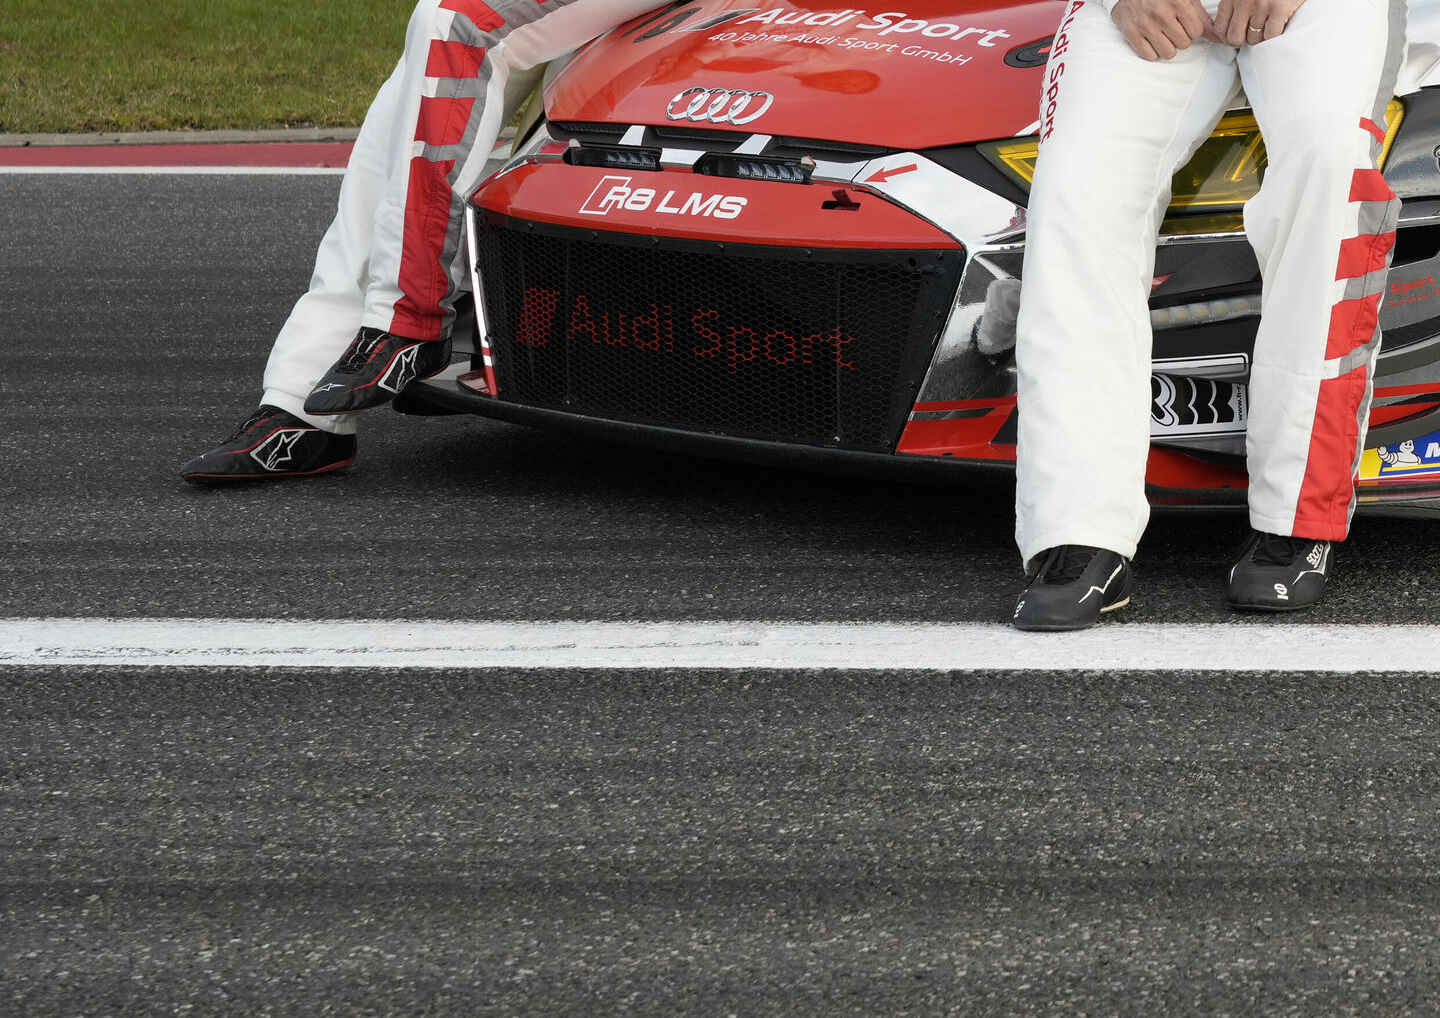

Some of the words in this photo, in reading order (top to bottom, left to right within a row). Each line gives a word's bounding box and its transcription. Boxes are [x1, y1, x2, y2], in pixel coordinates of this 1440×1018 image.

[738, 8, 865, 26] Audi
[856, 11, 1011, 47] Sport
[1052, 0, 1085, 60] Audi
[708, 32, 736, 42] 40
[734, 32, 788, 43] Jahre
[791, 33, 840, 45] Audi
[838, 37, 899, 53] Sport
[901, 45, 973, 66] GmbH
[1042, 62, 1065, 144] Sport
[599, 186, 656, 211] R8
[655, 190, 748, 219] LMS
[1390, 276, 1435, 294] Sport
[567, 295, 673, 353] Audi
[691, 307, 855, 373] Sport
